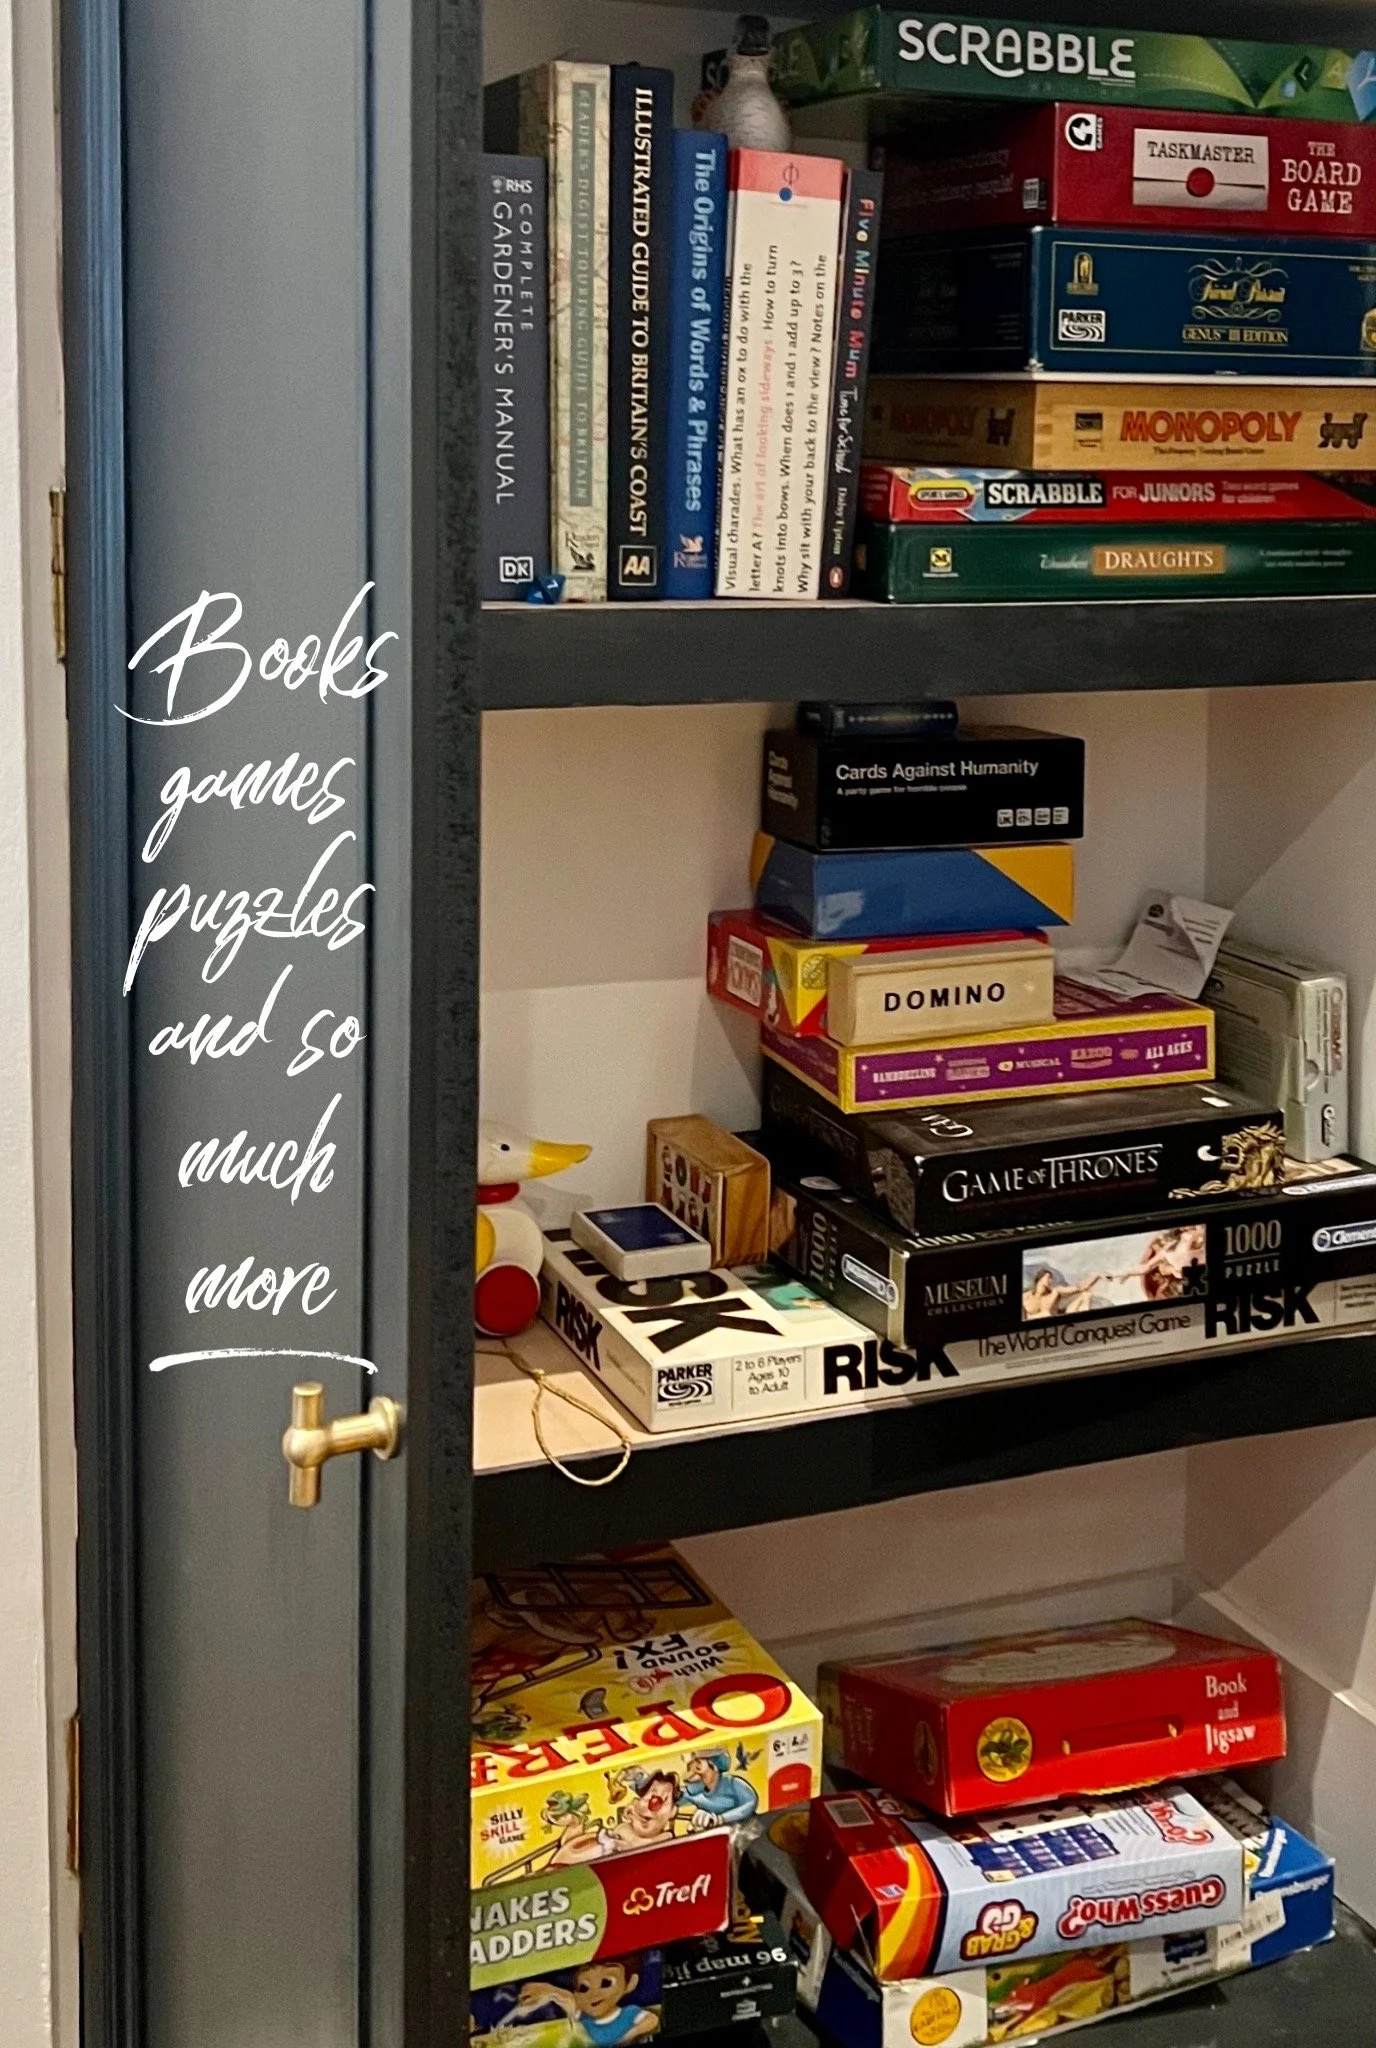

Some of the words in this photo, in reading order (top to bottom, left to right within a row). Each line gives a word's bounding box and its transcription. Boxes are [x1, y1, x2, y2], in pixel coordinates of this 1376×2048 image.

[898, 19, 1136, 79] SCRABBLE
[632, 87, 653, 239] ILLUSTRATED
[1147, 141, 1256, 165] TASKMASTER
[1307, 141, 1335, 157] THE
[694, 148, 717, 192] The
[1281, 159, 1361, 186] BOARD
[506, 179, 533, 194] RHS
[1287, 187, 1352, 214] GAME
[856, 199, 876, 242] Five
[688, 196, 716, 281] Origins
[519, 202, 534, 331] COMPLETE
[739, 262, 753, 286] the
[765, 244, 779, 277] turn
[813, 254, 827, 278] the
[493, 201, 514, 375] GARDENER'S
[632, 241, 651, 313] GUIDE
[764, 280, 776, 294] to
[789, 280, 800, 295] to
[815, 281, 826, 300] on
[849, 249, 871, 320] Minute
[690, 286, 713, 313] of
[738, 290, 751, 323] with
[762, 298, 776, 331] How
[789, 299, 803, 317] up
[631, 315, 649, 348] TO
[811, 303, 825, 343] Notes
[1061, 312, 1103, 324] PARKER
[736, 326, 749, 345] do
[785, 321, 799, 349] add
[1243, 329, 1289, 343] EDITION
[687, 317, 712, 392] Words
[737, 347, 748, 362] to
[844, 329, 866, 378] Mum
[736, 367, 747, 384] ox
[784, 361, 797, 389] and
[630, 353, 649, 460] BRITAIN'S
[686, 398, 706, 414] &
[735, 387, 746, 405] an
[806, 393, 819, 416] the
[838, 385, 859, 417] Time
[732, 408, 745, 433] has
[756, 406, 773, 458] looking
[781, 401, 795, 433] does
[806, 418, 818, 434] to
[1119, 410, 1302, 442] MONOPOLY
[495, 387, 515, 505] MANUAL
[731, 437, 744, 475] What
[779, 437, 793, 478] When
[803, 437, 817, 469] back
[685, 419, 709, 512] Phrases
[753, 459, 767, 477] of
[630, 465, 648, 537] COAST
[753, 481, 766, 501] art
[776, 480, 790, 520] bows.
[804, 473, 817, 505] your
[987, 482, 1103, 505] SCRABBLE
[1112, 486, 1137, 499] FOR
[1138, 482, 1216, 503] JUNIORS
[727, 478, 742, 544] charades.
[752, 505, 765, 530] The
[801, 508, 813, 539] with
[775, 522, 788, 551] into
[799, 543, 811, 560] sit
[623, 555, 651, 576] AA
[724, 548, 738, 591] Visual
[748, 554, 763, 592] letter
[773, 555, 787, 593] knots
[1104, 550, 1214, 571] DRAUGHTS
[797, 562, 813, 594] Why
[835, 764, 888, 781] Cards
[892, 761, 956, 781] Against
[960, 758, 1039, 777] Humanity
[884, 982, 1005, 1012] DOMINO
[1145, 1046, 1165, 1061] ALL
[1166, 1041, 1194, 1058] AGES
[941, 1166, 1023, 1203] GAME
[1041, 1143, 1163, 1190] THRONES
[809, 1211, 827, 1281] 1000
[1223, 1219, 1282, 1257] 1000
[1224, 1258, 1281, 1279] PUZZLE
[923, 1273, 1009, 1308] MUSEUM
[556, 1280, 603, 1371] RISK
[1205, 1284, 1319, 1339] RISK
[979, 1336, 1005, 1358] The
[1006, 1325, 1058, 1354] World
[1061, 1315, 1137, 1346] Conquest
[1139, 1313, 1192, 1336] Game
[657, 1363, 713, 1383] PARKER
[735, 1360, 743, 1371] 2
[744, 1360, 755, 1371] to
[767, 1353, 802, 1371] Players
[748, 1370, 776, 1384] Ages
[778, 1366, 790, 1378] 10
[823, 1339, 959, 1395] RISK
[749, 1385, 760, 1396] to
[762, 1380, 789, 1393] Adult
[641, 1640, 732, 1670] SOUND
[672, 1654, 725, 1679] With
[1204, 1672, 1248, 1699] Book
[1217, 1700, 1240, 1721] and
[1204, 1722, 1257, 1756] Jigsaw
[480, 1822, 520, 1842] SKILL
[489, 1807, 524, 1827] SILLY
[655, 1873, 712, 1908] Trefl
[981, 1901, 1021, 1935] GO
[1018, 1916, 1036, 1939] &
[1059, 1894, 1142, 1939] Who?
[755, 1946, 787, 1966] 96
[965, 1927, 1022, 1958] GRAB
[694, 1953, 753, 1974] map
